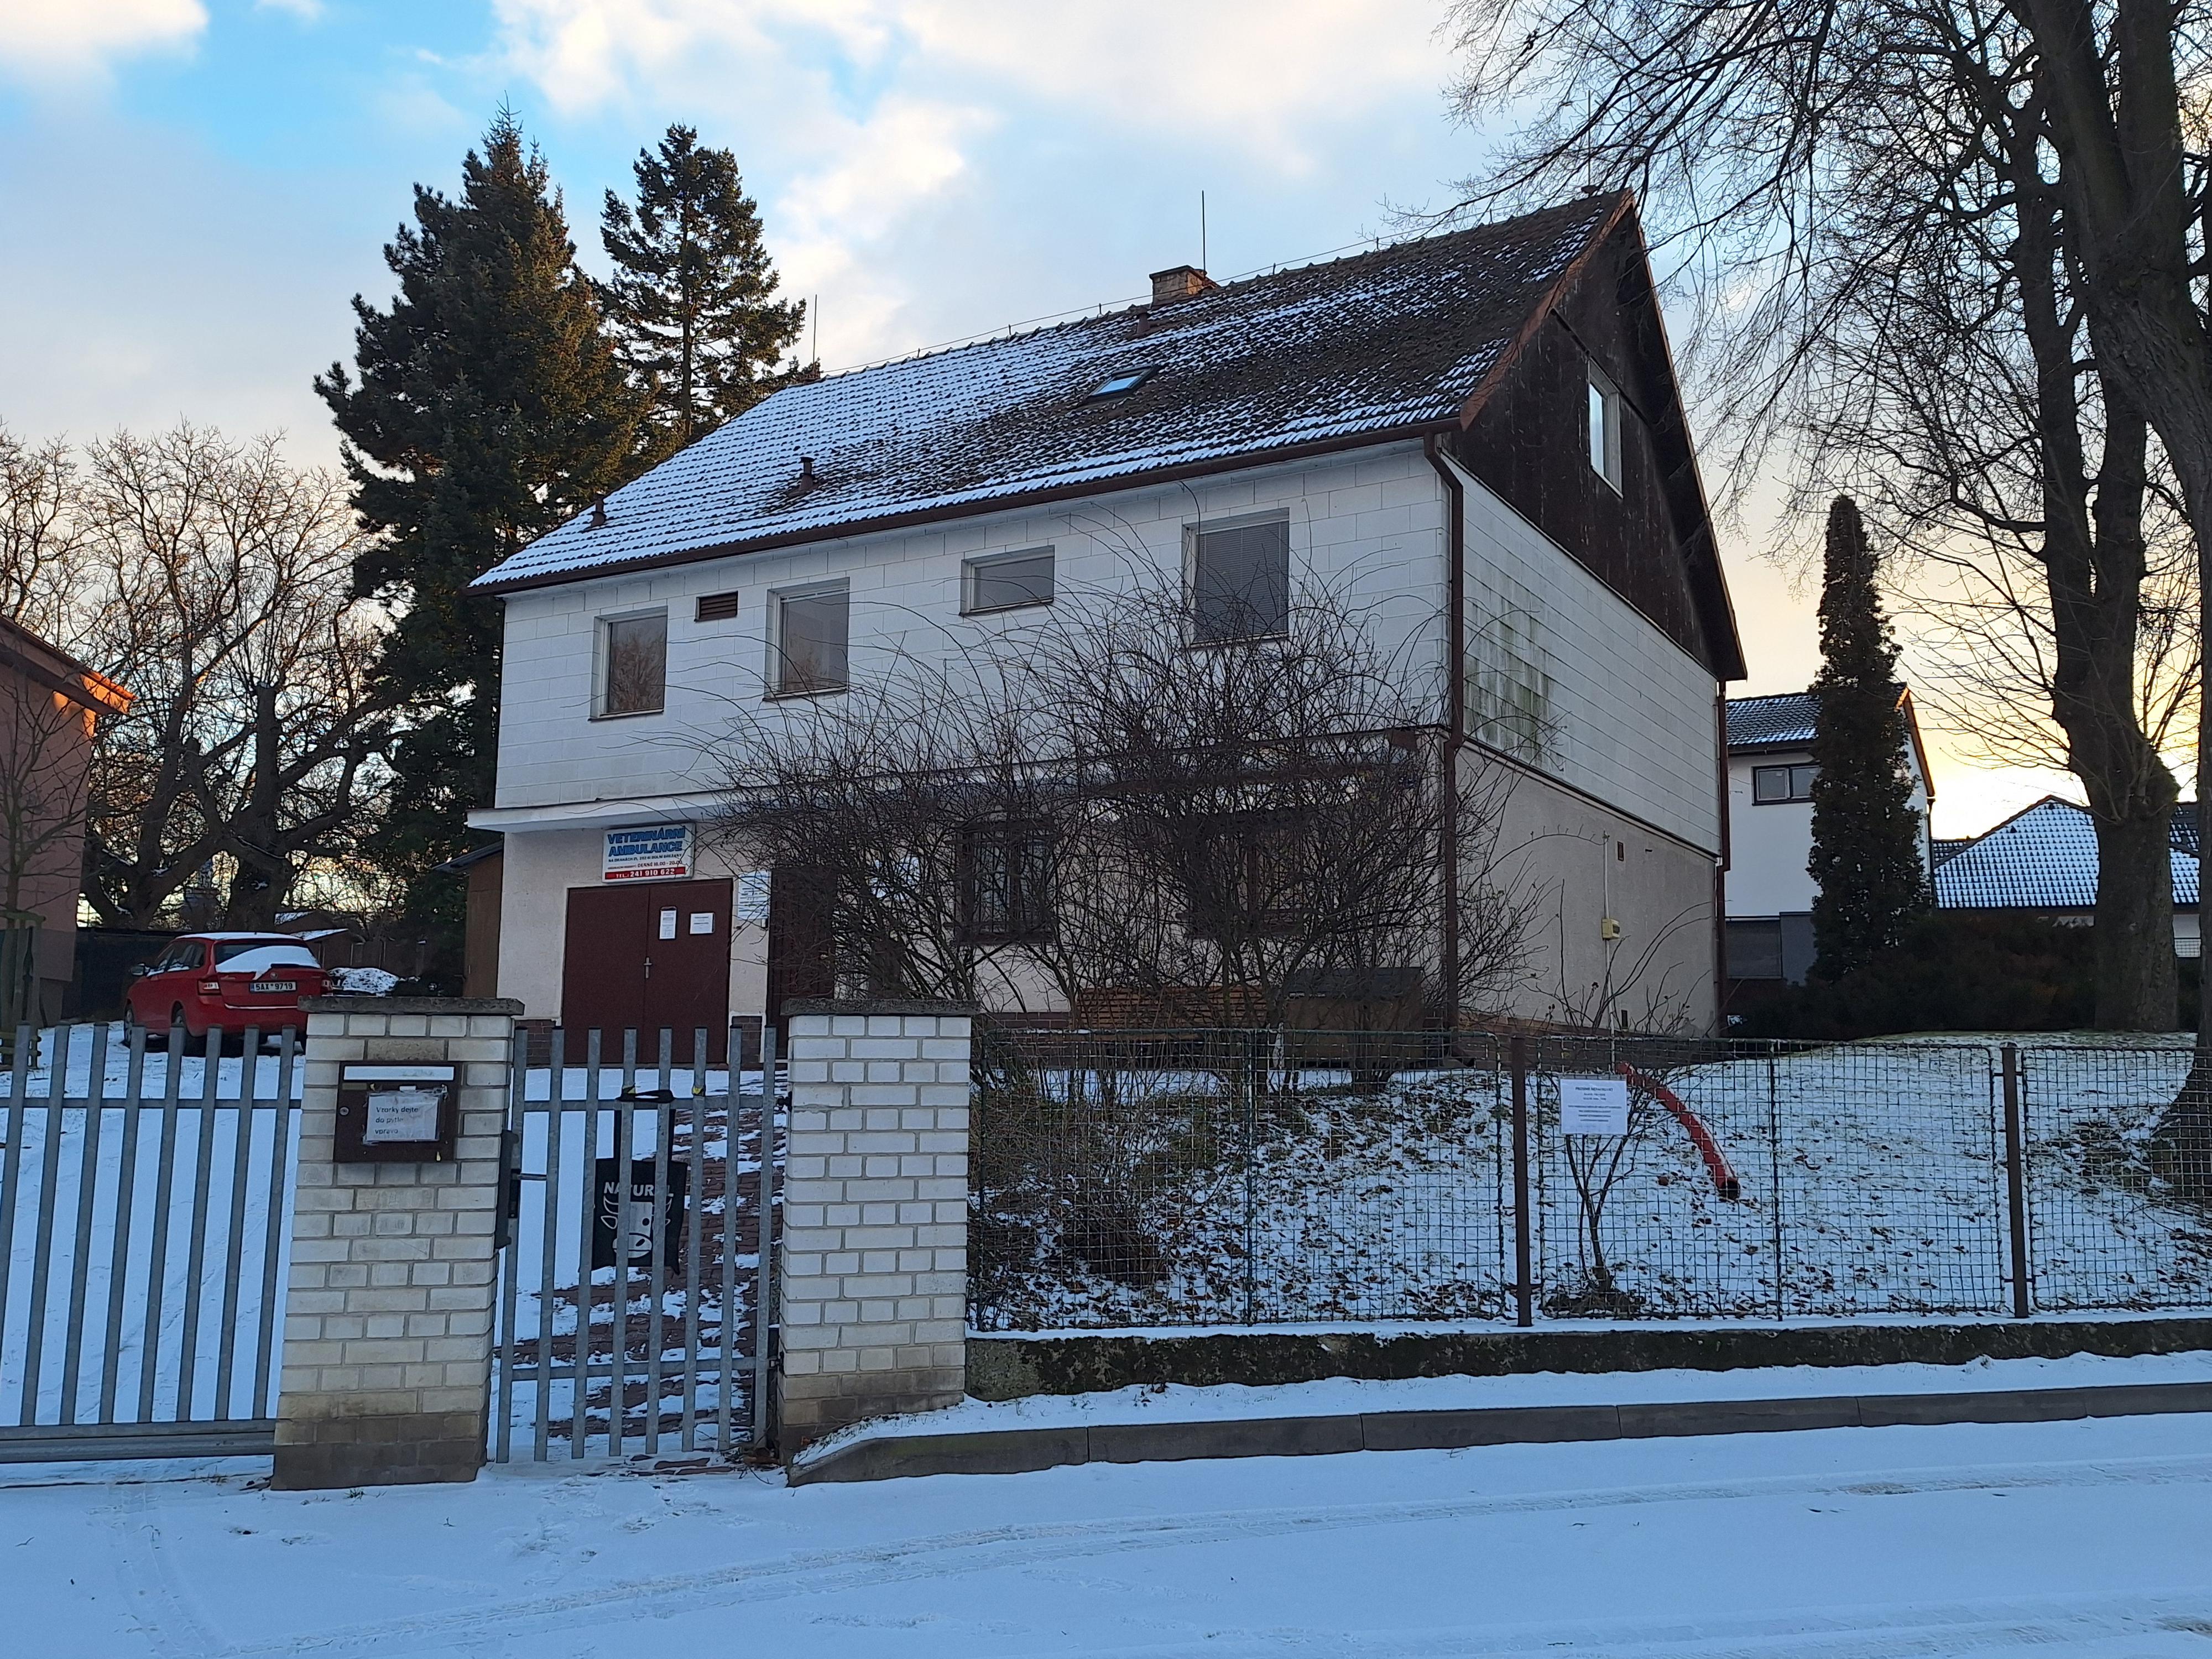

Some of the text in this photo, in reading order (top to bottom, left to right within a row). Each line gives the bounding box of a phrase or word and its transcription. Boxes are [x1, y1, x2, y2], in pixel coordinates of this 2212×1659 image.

[608, 826, 686, 844] VETERINÁRNÍ
[608, 841, 683, 857] AMBULANCE
[604, 1182, 674, 1197] NURL
